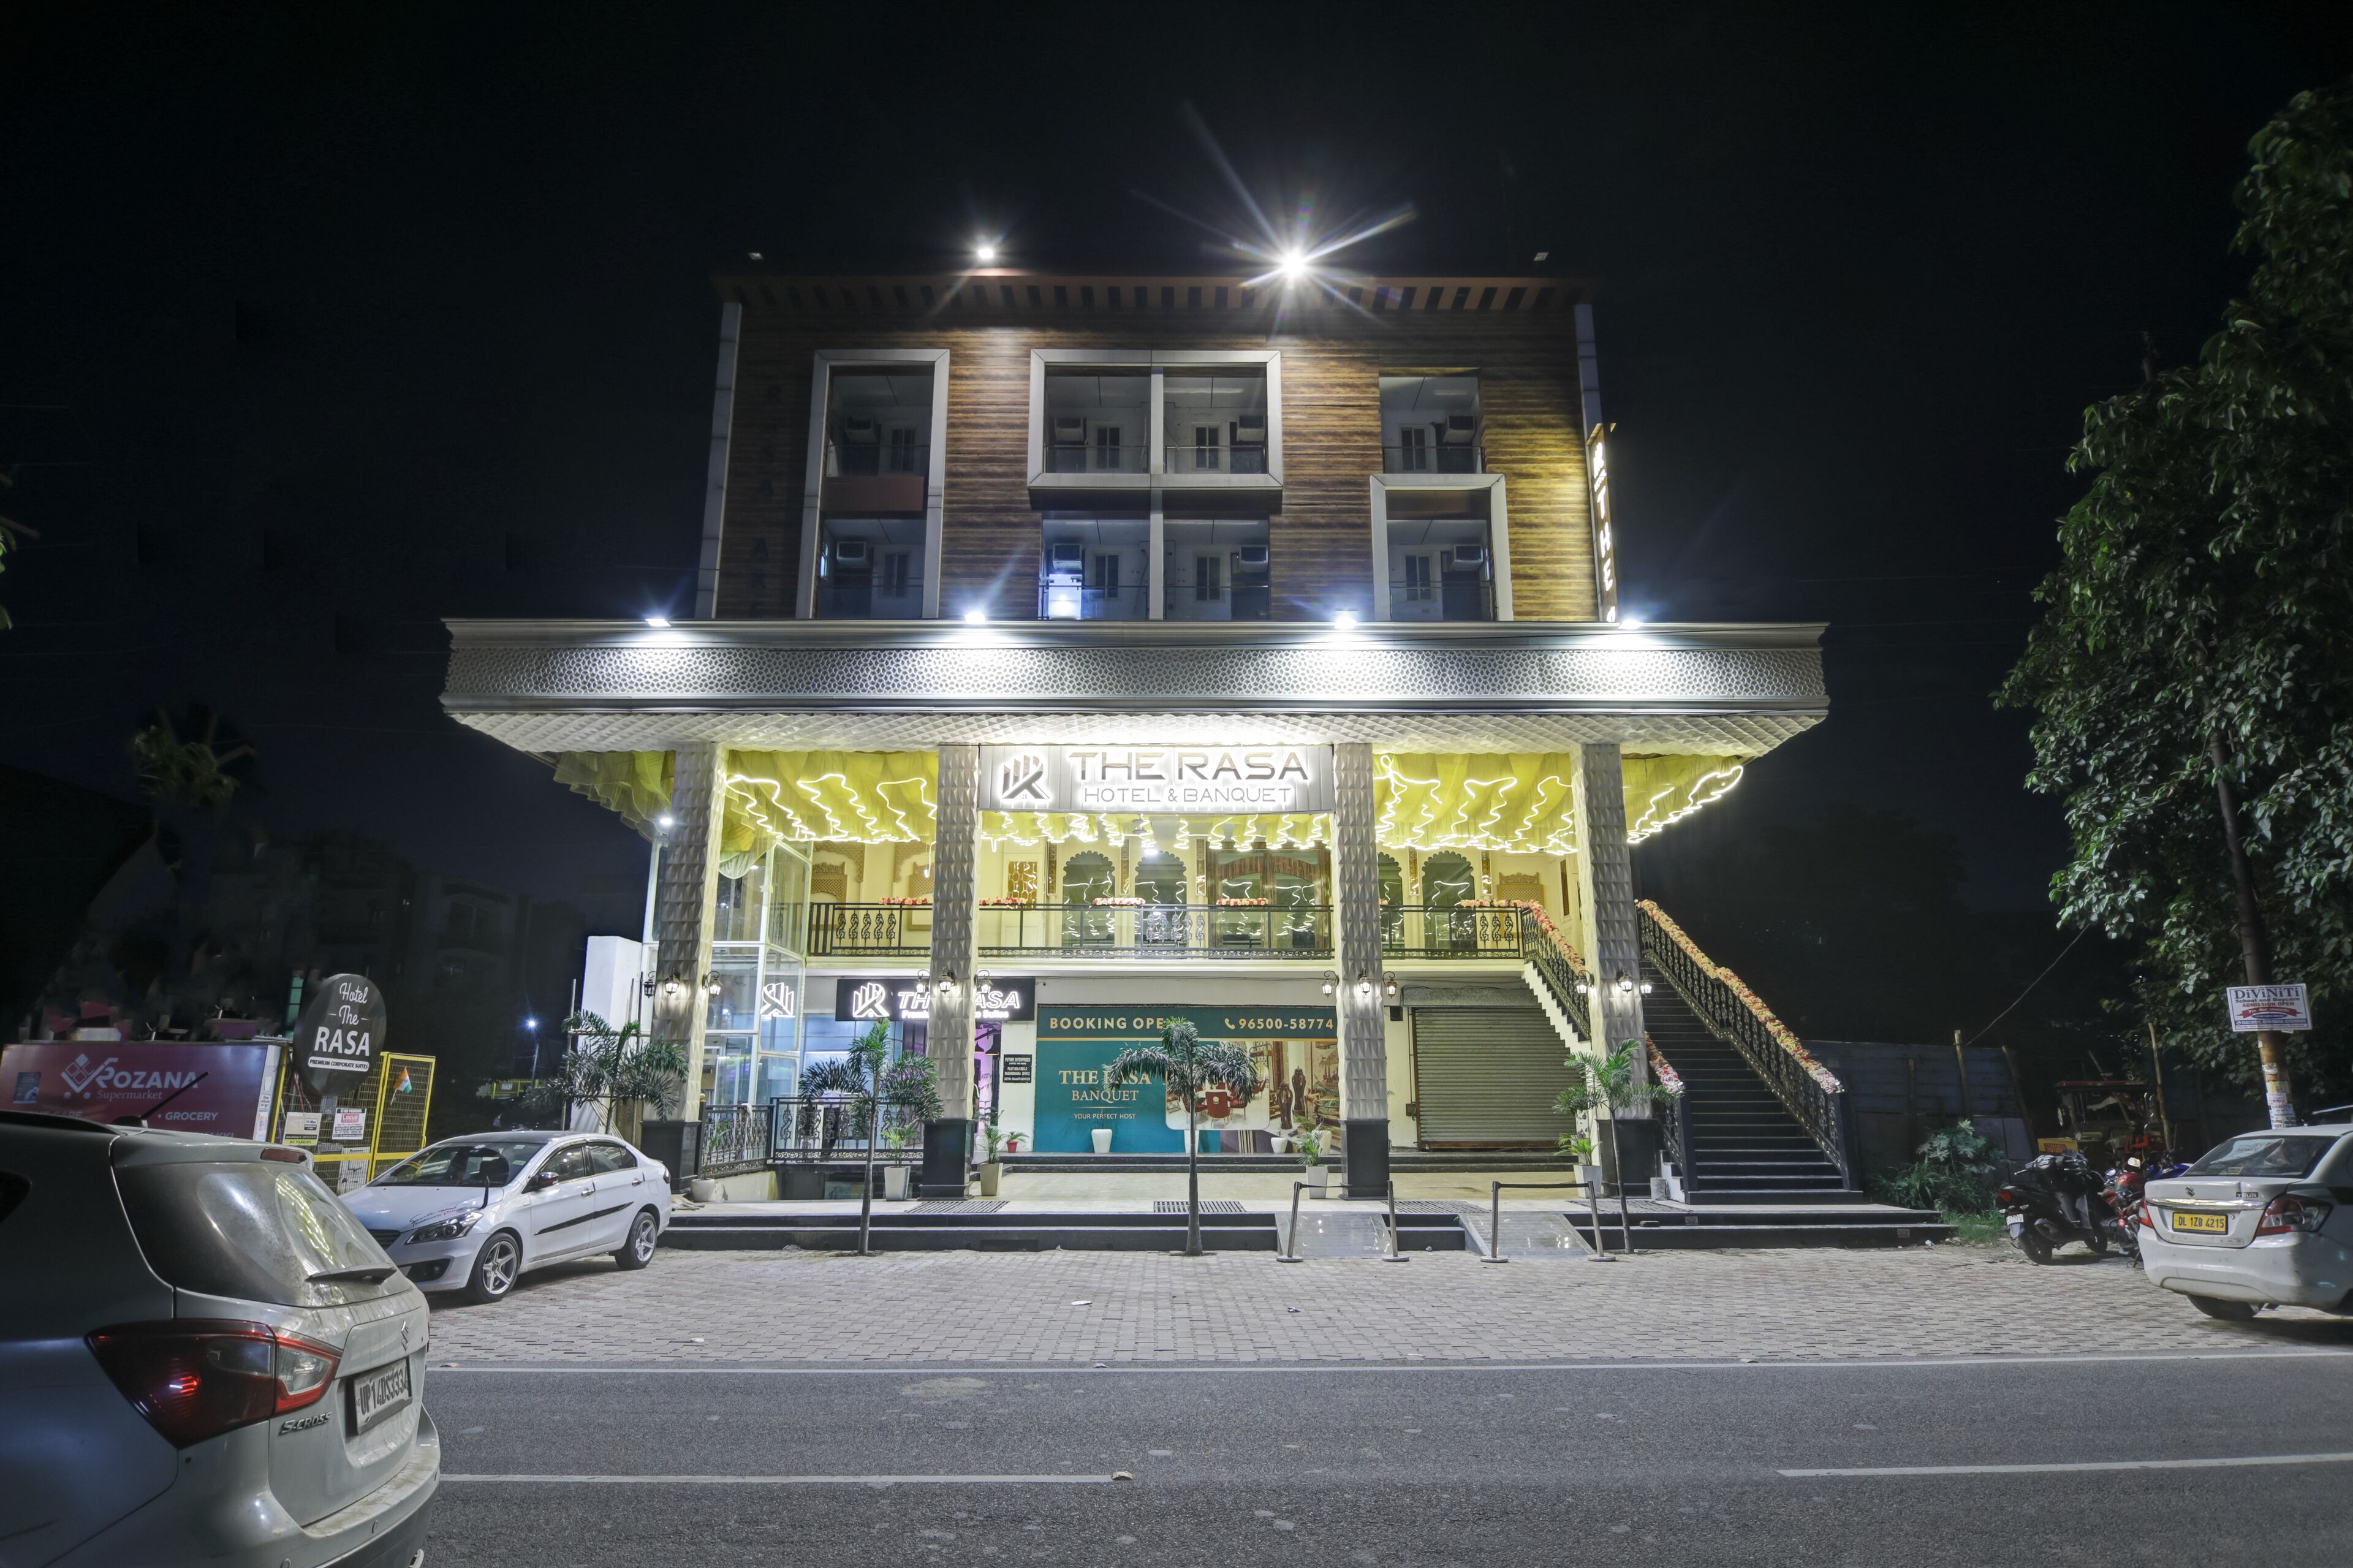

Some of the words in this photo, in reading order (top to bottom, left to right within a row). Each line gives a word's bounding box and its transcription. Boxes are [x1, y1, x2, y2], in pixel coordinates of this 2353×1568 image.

[1069, 752, 1165, 780] THE
[1177, 752, 1309, 780] RASA
[1084, 788, 1161, 803] HOTEL
[1167, 788, 1178, 803] &
[1183, 788, 1292, 803] BANQUET
[339, 982, 368, 1004] Hotel
[898, 991, 930, 1009] TH
[974, 991, 1020, 1009] ASA
[339, 1005, 359, 1025] The
[982, 1010, 1009, 1018] Suites
[1050, 1017, 1127, 1029] BOOKING
[1132, 1017, 1164, 1029] OPE
[1238, 1018, 1333, 1029] 96500-58774
[314, 1026, 369, 1056] RASA
[96, 1058, 199, 1088] ROZANA
[1058, 1070, 1099, 1085] THE
[97, 1090, 162, 1102] Supermarket
[1071, 1090, 1139, 1104] BANQUET
[165, 1112, 218, 1121] GROCERY
[2178, 1216, 2187, 1226] DL
[2191, 1217, 2203, 1227] 1ZB
[2206, 1218, 2224, 1229] 4215
